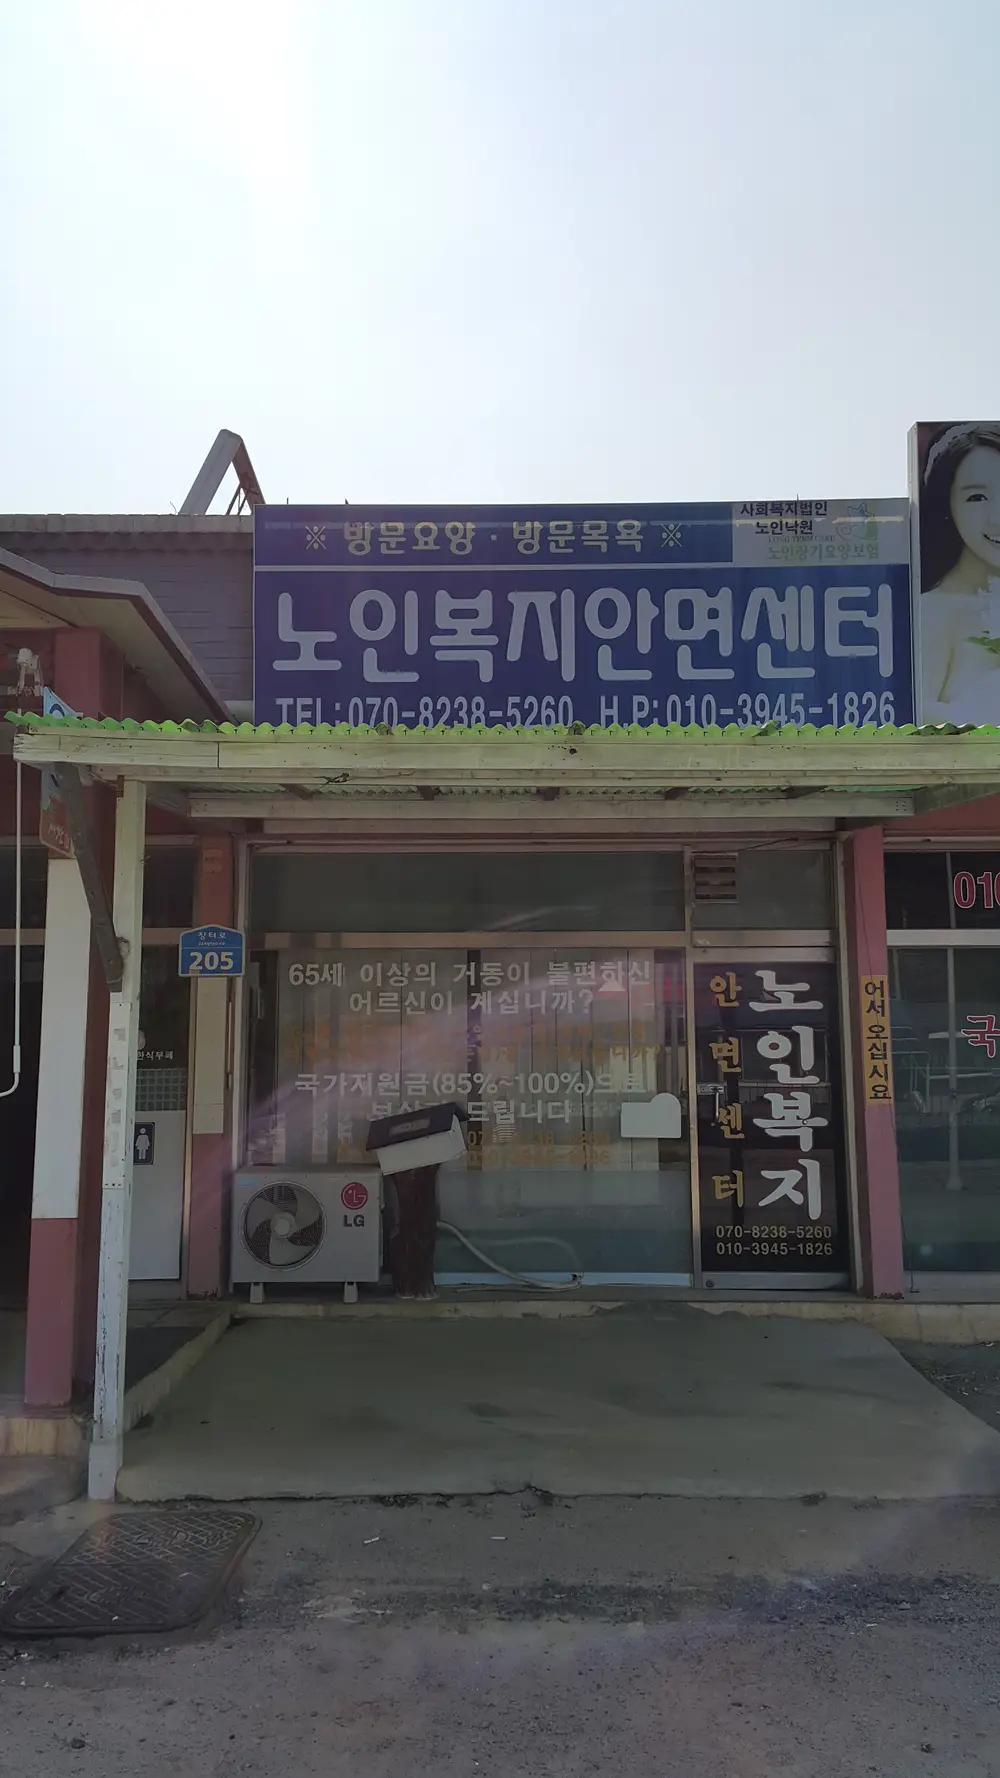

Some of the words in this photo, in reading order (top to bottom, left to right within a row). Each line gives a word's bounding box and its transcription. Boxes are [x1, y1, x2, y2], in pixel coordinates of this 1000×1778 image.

[740, 501, 828, 517] 사회복지법인
[344, 521, 477, 555] 방문요양
[512, 519, 643, 555] 방문목욕
[755, 520, 813, 535] 노인낙원
[767, 543, 879, 561] 노인장기요양보험
[272, 583, 894, 683] 노인복지안면센터
[953, 871, 1000, 909] 01
[198, 931, 227, 941] 장터로
[188, 951, 234, 971] 205
[289, 962, 343, 987] 65세
[360, 961, 436, 987] 이상의
[453, 961, 530, 987] 거동이
[547, 960, 651, 986] 불편하신
[350, 990, 453, 1016] 어르신이
[470, 988, 594, 1015] 계십니까?
[709, 972, 745, 1208] 안면센터
[749, 969, 829, 1221] 노인복지
[467, 1099, 571, 1124] 드립니다
[343, 1214, 365, 1228] LG
[716, 1225, 833, 1239] 070-8238-5260
[716, 1242, 833, 1256] 010-3945-1826
